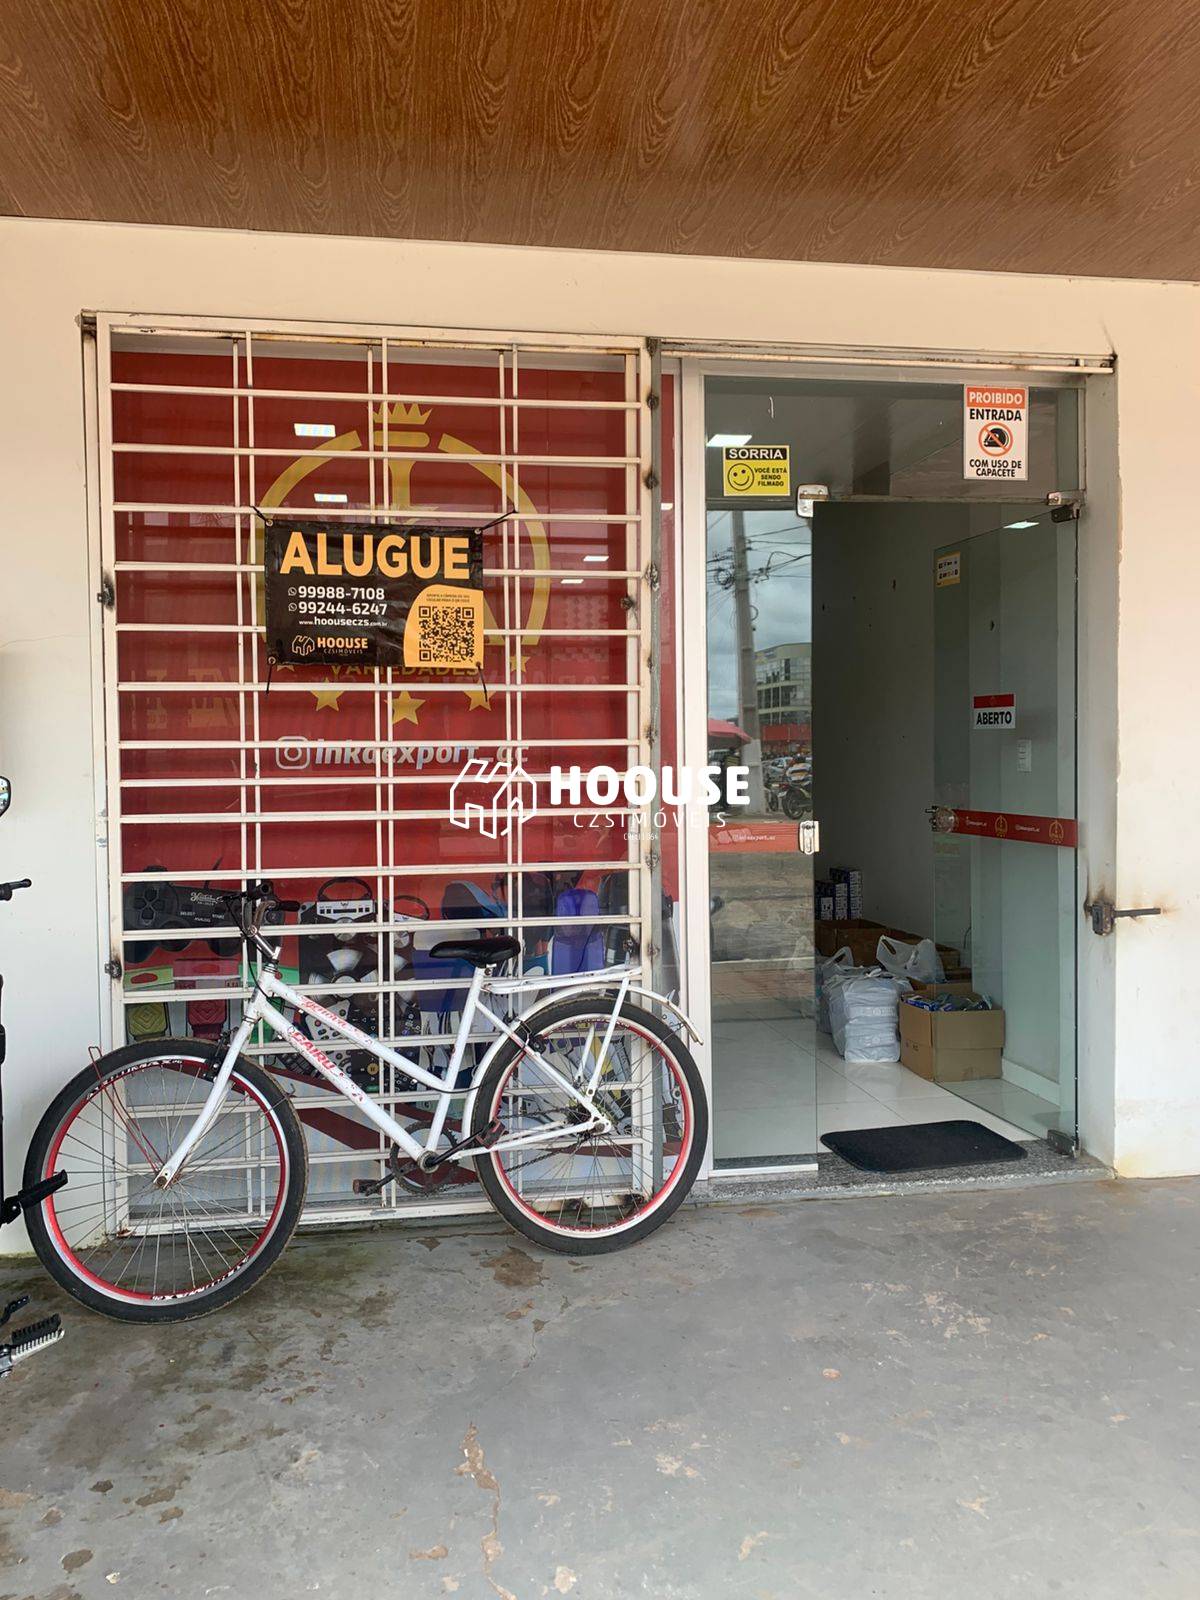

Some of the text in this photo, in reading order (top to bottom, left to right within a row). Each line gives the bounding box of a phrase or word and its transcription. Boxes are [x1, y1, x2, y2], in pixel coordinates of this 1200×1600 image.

[969, 391, 1023, 405] PROIBIDO
[969, 408, 1022, 422] ENTRADA
[728, 448, 784, 460] SORRIA
[754, 466, 787, 474] VOCÊ ESTÁ
[969, 459, 1022, 470] COM USO DE
[975, 468, 1016, 478] CAPACETE
[280, 531, 470, 580] ALUGUE
[298, 586, 385, 600] 99988-7108
[298, 602, 388, 616] 99244-6247
[299, 616, 388, 627] www.hoouseczs.com.br
[317, 637, 369, 649] HOOUSE
[976, 711, 1012, 725] ABERTO
[291, 1031, 337, 1071] CAIRU
